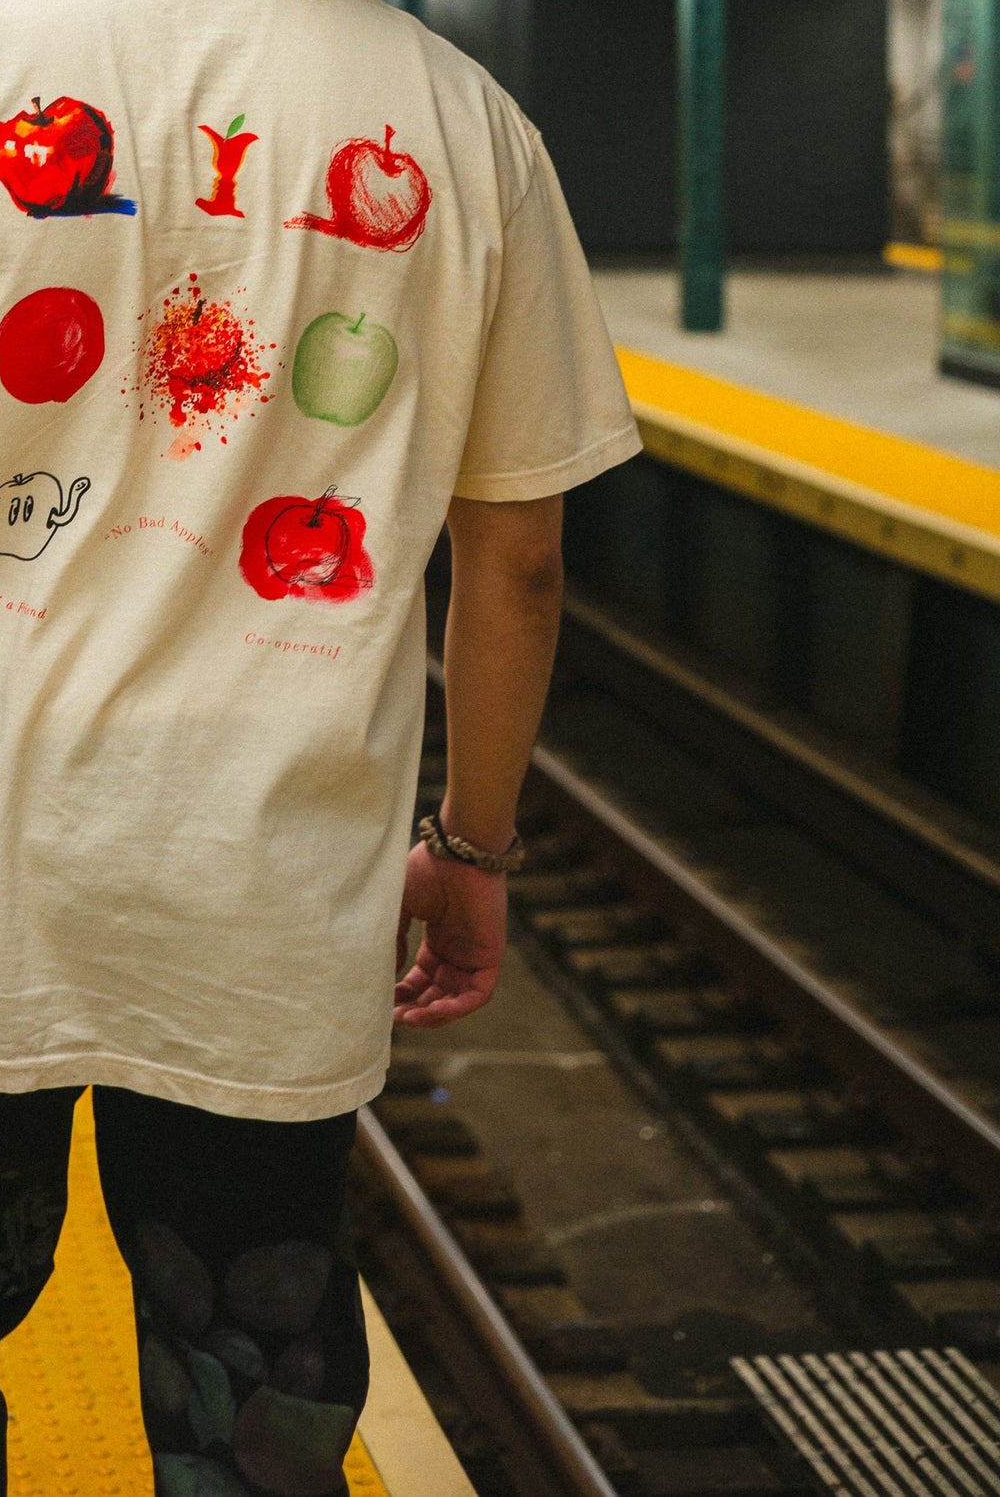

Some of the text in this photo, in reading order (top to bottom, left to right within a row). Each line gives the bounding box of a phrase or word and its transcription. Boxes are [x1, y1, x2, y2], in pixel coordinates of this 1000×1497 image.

[138, 515, 165, 529] Bad
[6, 601, 13, 610] a
[244, 632, 342, 660] Co-operatif
